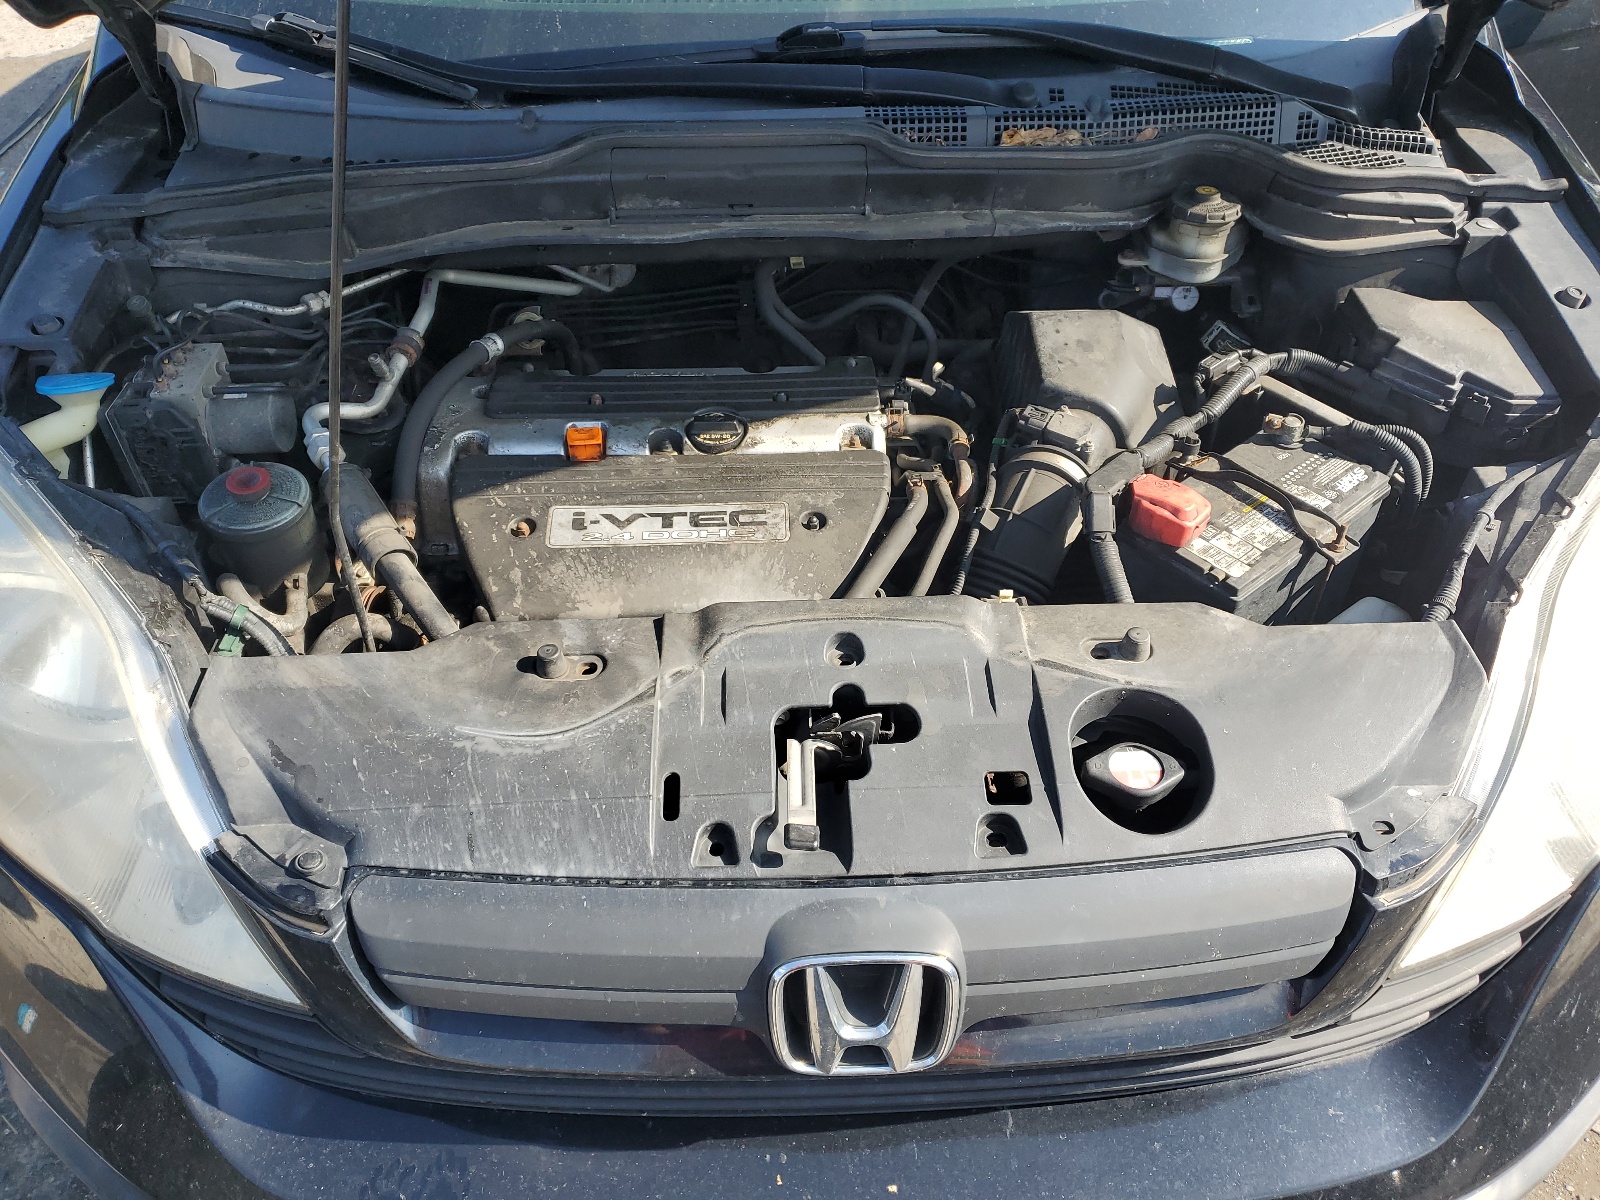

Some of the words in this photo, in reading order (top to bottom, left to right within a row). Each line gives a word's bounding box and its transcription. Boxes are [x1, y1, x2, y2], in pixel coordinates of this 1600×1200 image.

[572, 510, 767, 531] i-VTEC
[582, 532, 635, 541] 2.4
[642, 529, 756, 540] DOHC
